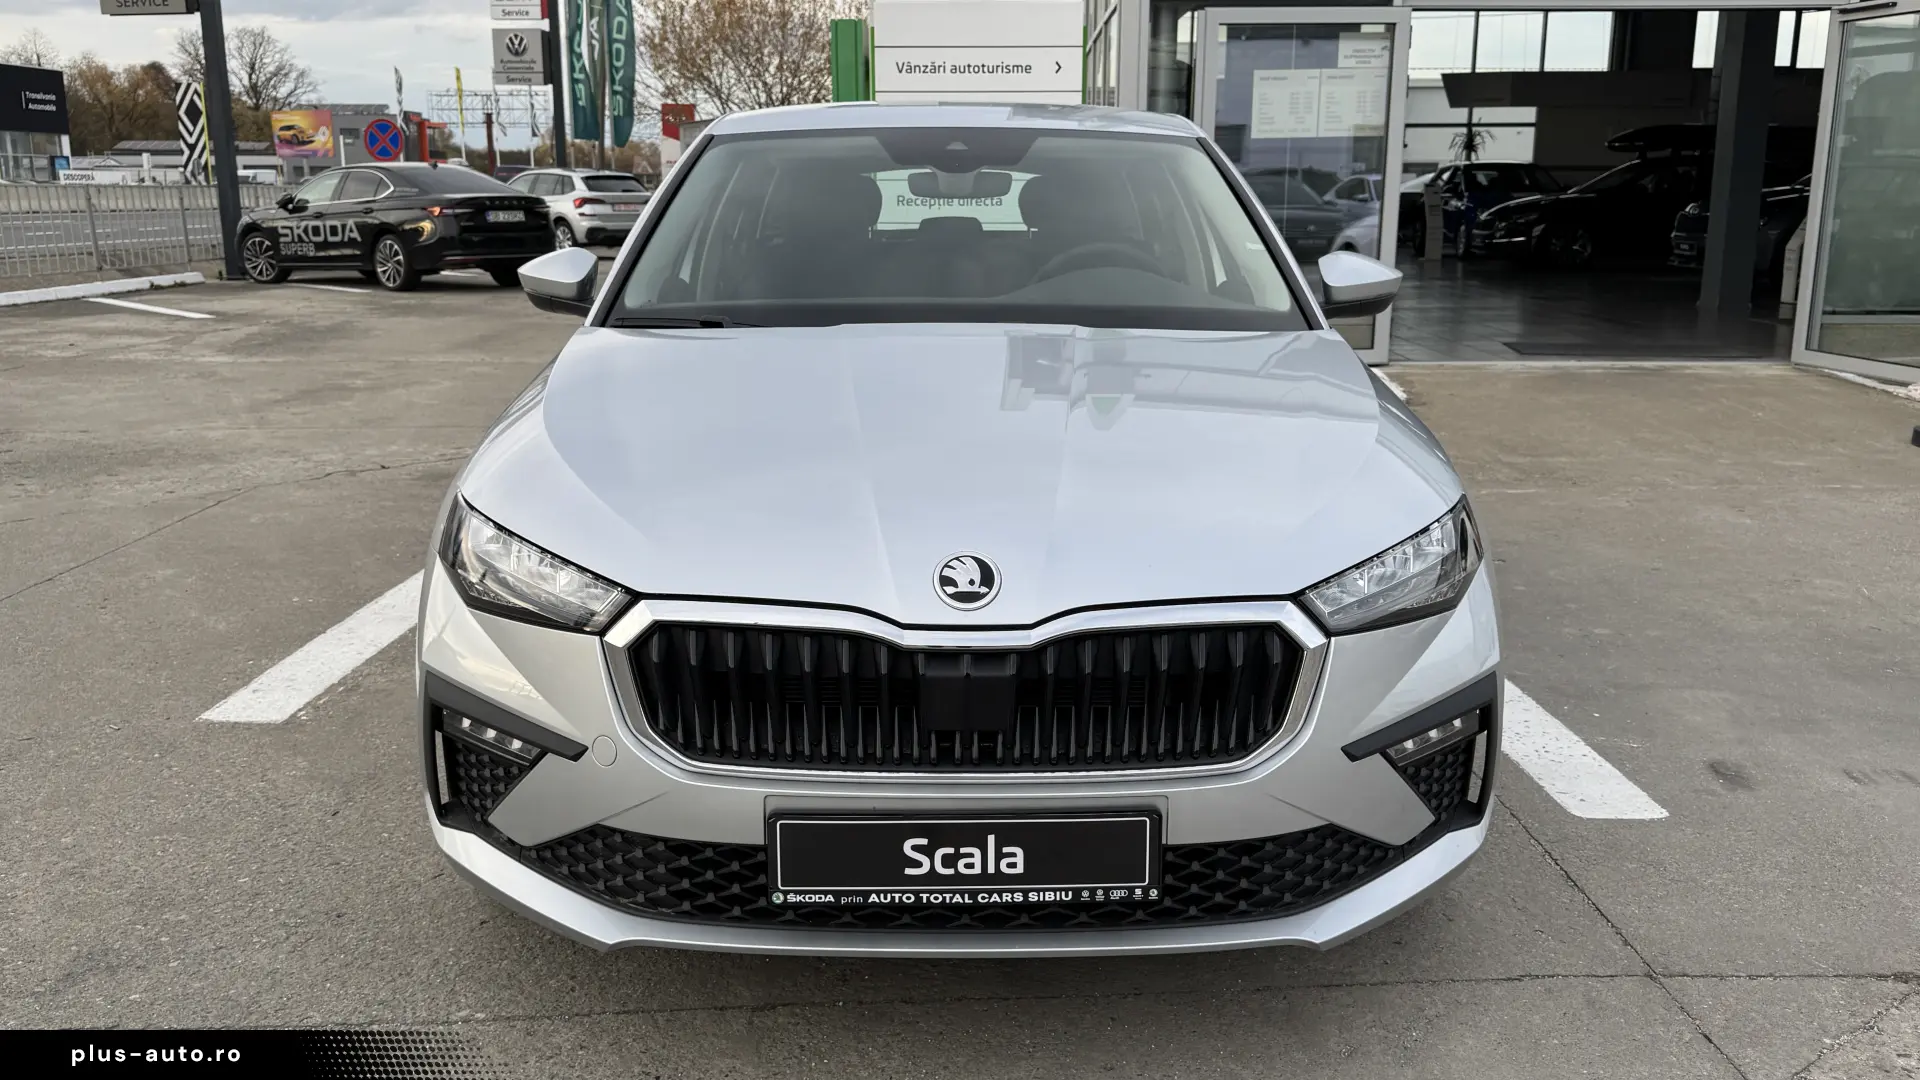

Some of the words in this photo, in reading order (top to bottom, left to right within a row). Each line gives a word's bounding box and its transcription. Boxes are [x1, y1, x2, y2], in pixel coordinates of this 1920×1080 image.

[501, 8, 530, 17] Service
[895, 61, 946, 74] Vânzări
[949, 61, 1032, 75] autoturisme
[280, 243, 315, 257] SUPERB
[903, 834, 1024, 876] Scala
[786, 892, 835, 903] ŠKODA
[841, 895, 863, 905] prin
[867, 893, 915, 904] AUTO
[919, 892, 974, 904] TOTAL
[977, 891, 1024, 904] CARS
[1028, 890, 1073, 902] SIBIU
